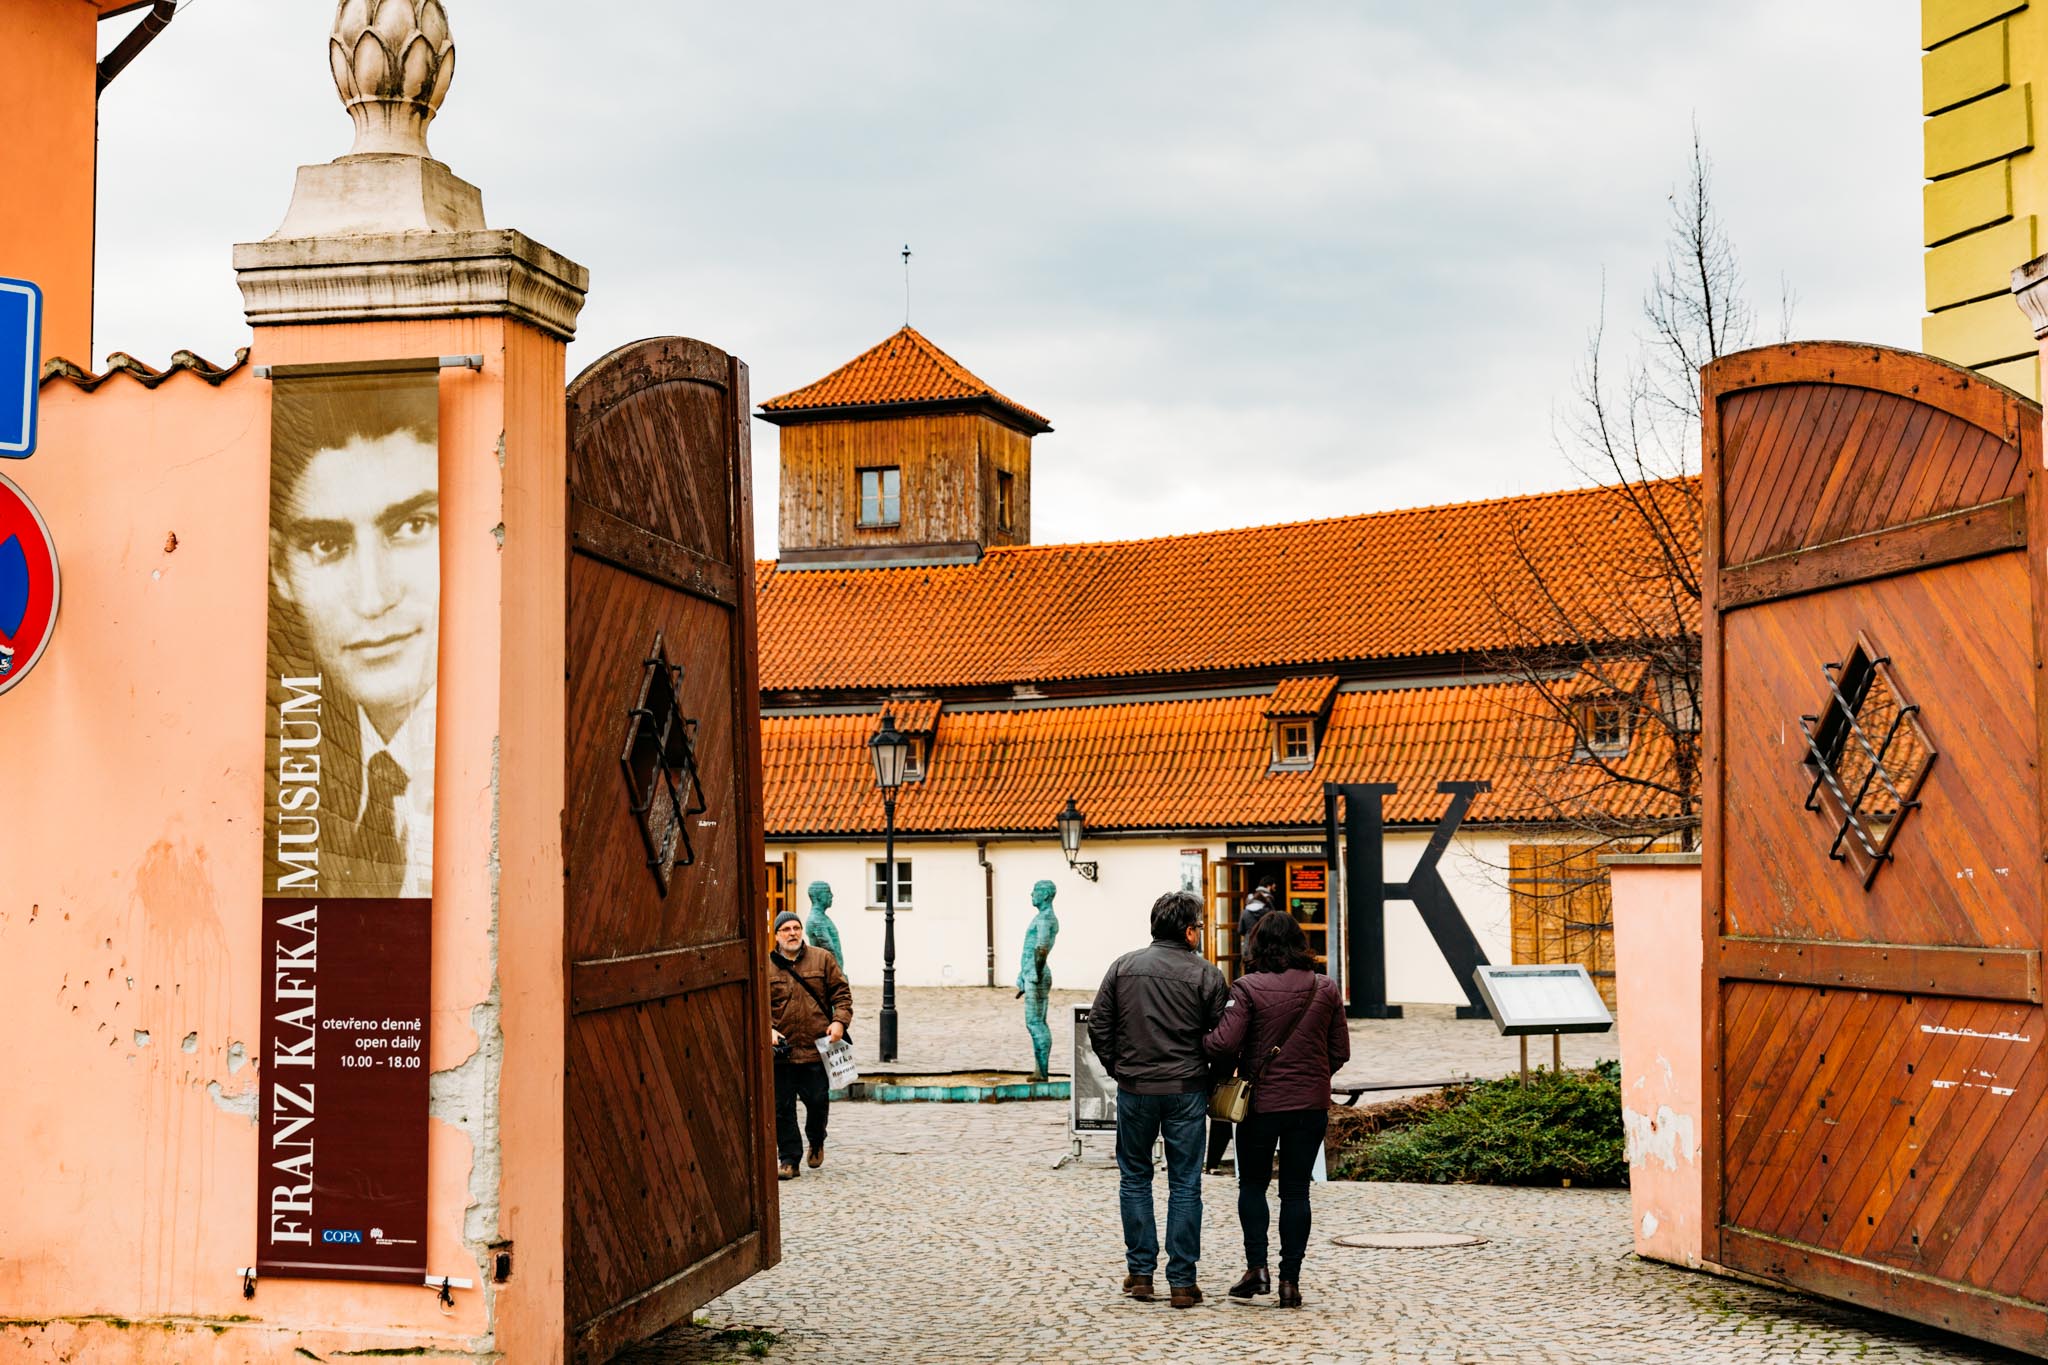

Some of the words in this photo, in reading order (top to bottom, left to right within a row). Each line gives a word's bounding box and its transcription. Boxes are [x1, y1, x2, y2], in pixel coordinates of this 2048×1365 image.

[277, 672, 322, 892] MUSEUM
[1236, 845, 1260, 854] FRANZ
[1261, 845, 1286, 854] KAFKA
[1288, 845, 1322, 854] MUSEUM
[1325, 782, 1492, 1019] K
[274, 905, 318, 1070] KAFKA
[322, 1017, 378, 1030] otevřeno
[381, 1017, 421, 1030] denně
[355, 1038, 388, 1051] open
[391, 1035, 421, 1052] daily
[340, 1055, 373, 1068] 10.00
[387, 1056, 421, 1068] 18.00
[271, 1083, 315, 1246] FRANZ
[323, 1230, 361, 1243] COPA
